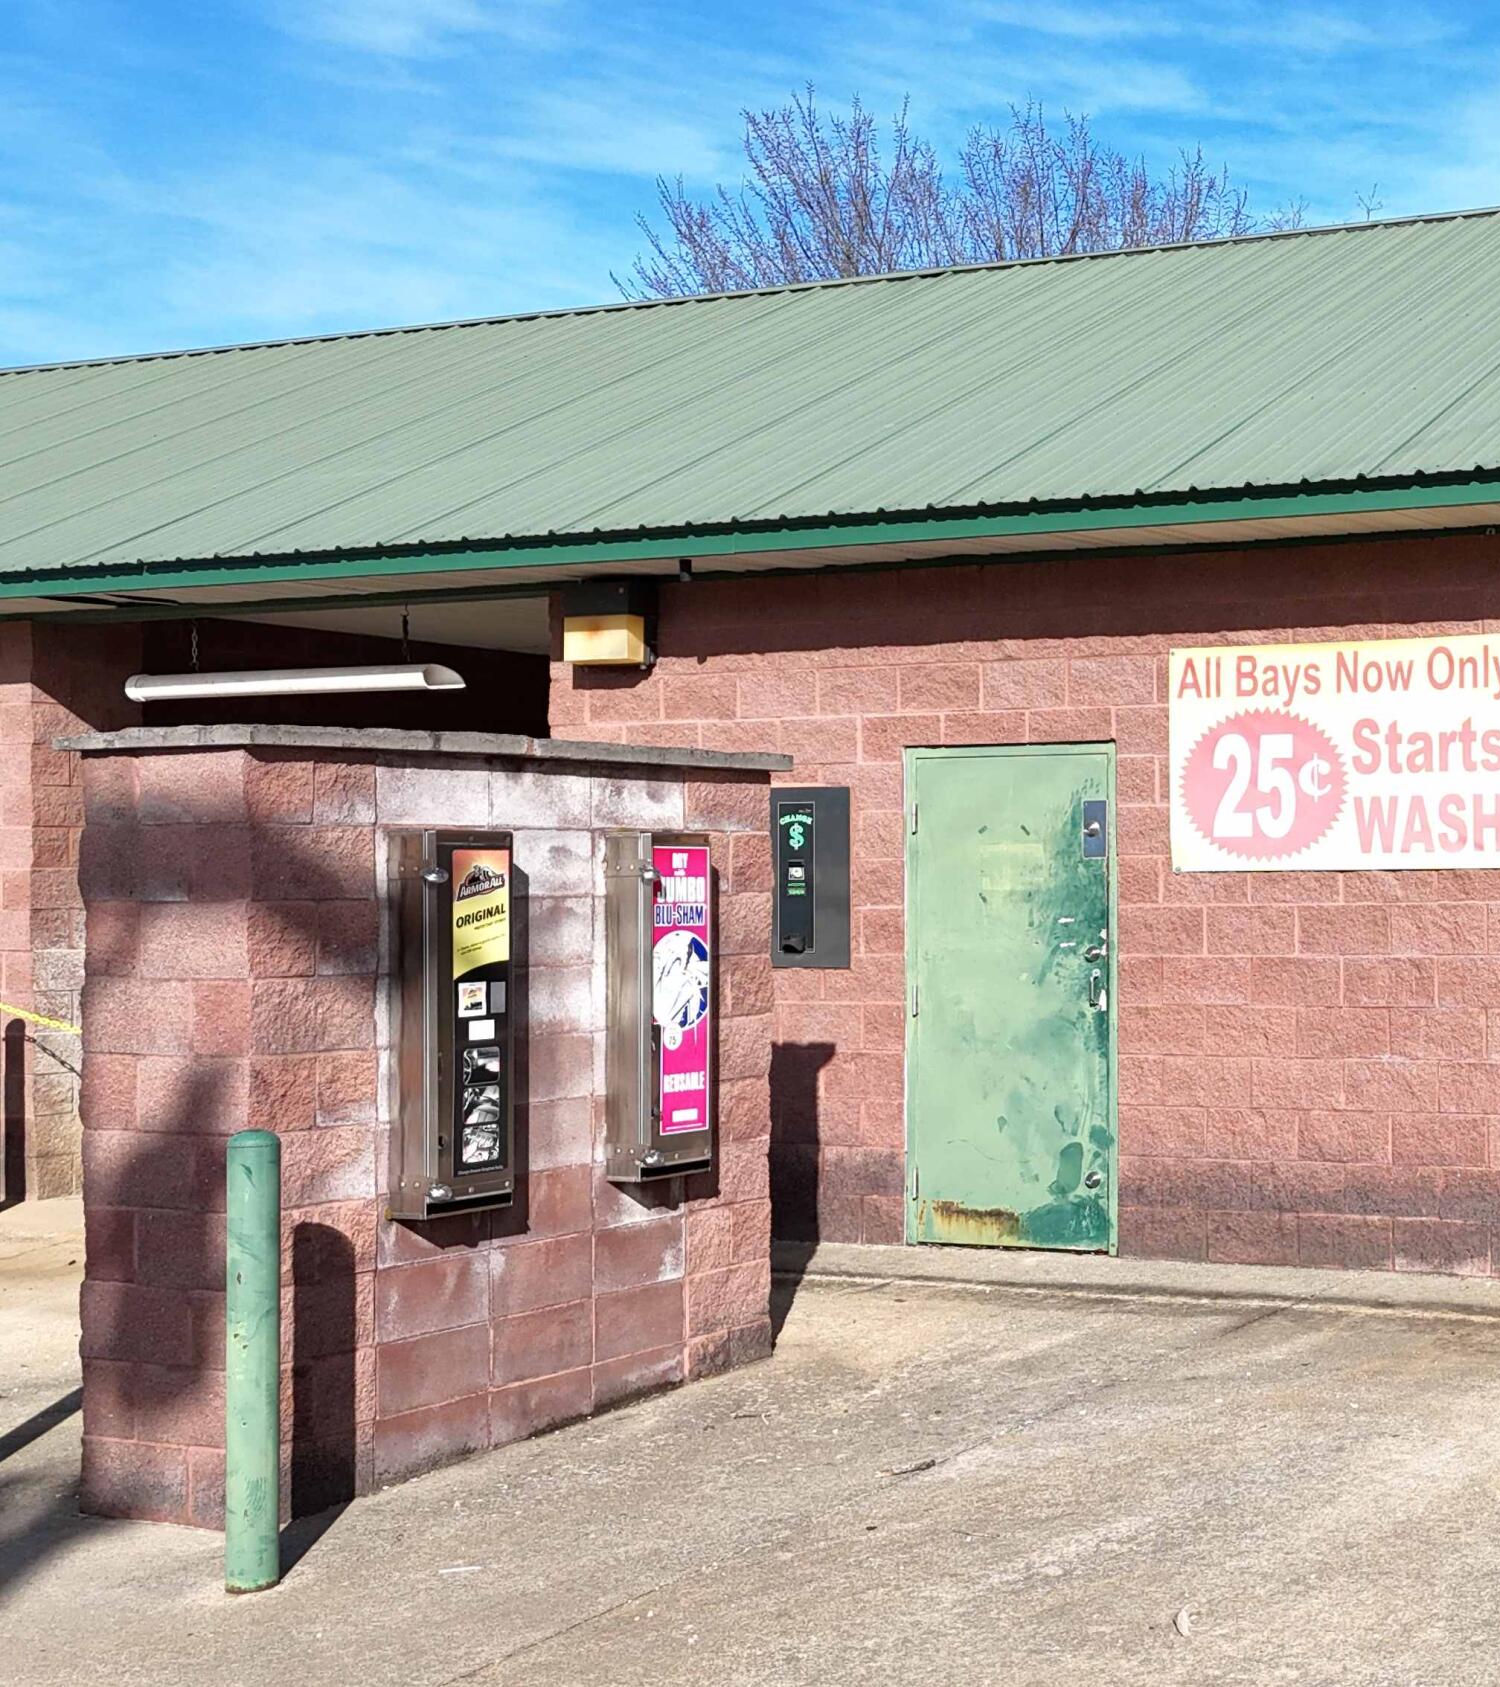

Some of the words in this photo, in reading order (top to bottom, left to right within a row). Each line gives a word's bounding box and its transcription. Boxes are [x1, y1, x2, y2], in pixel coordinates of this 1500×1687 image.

[1177, 656, 1222, 699] All
[1235, 655, 1322, 707] Bays
[1335, 651, 1414, 694] Now
[1212, 732, 1333, 839] 25¢
[656, 876, 706, 903] JUMBO
[456, 903, 507, 929] ORIGINAL
[655, 904, 705, 925] BLU-SHAM
